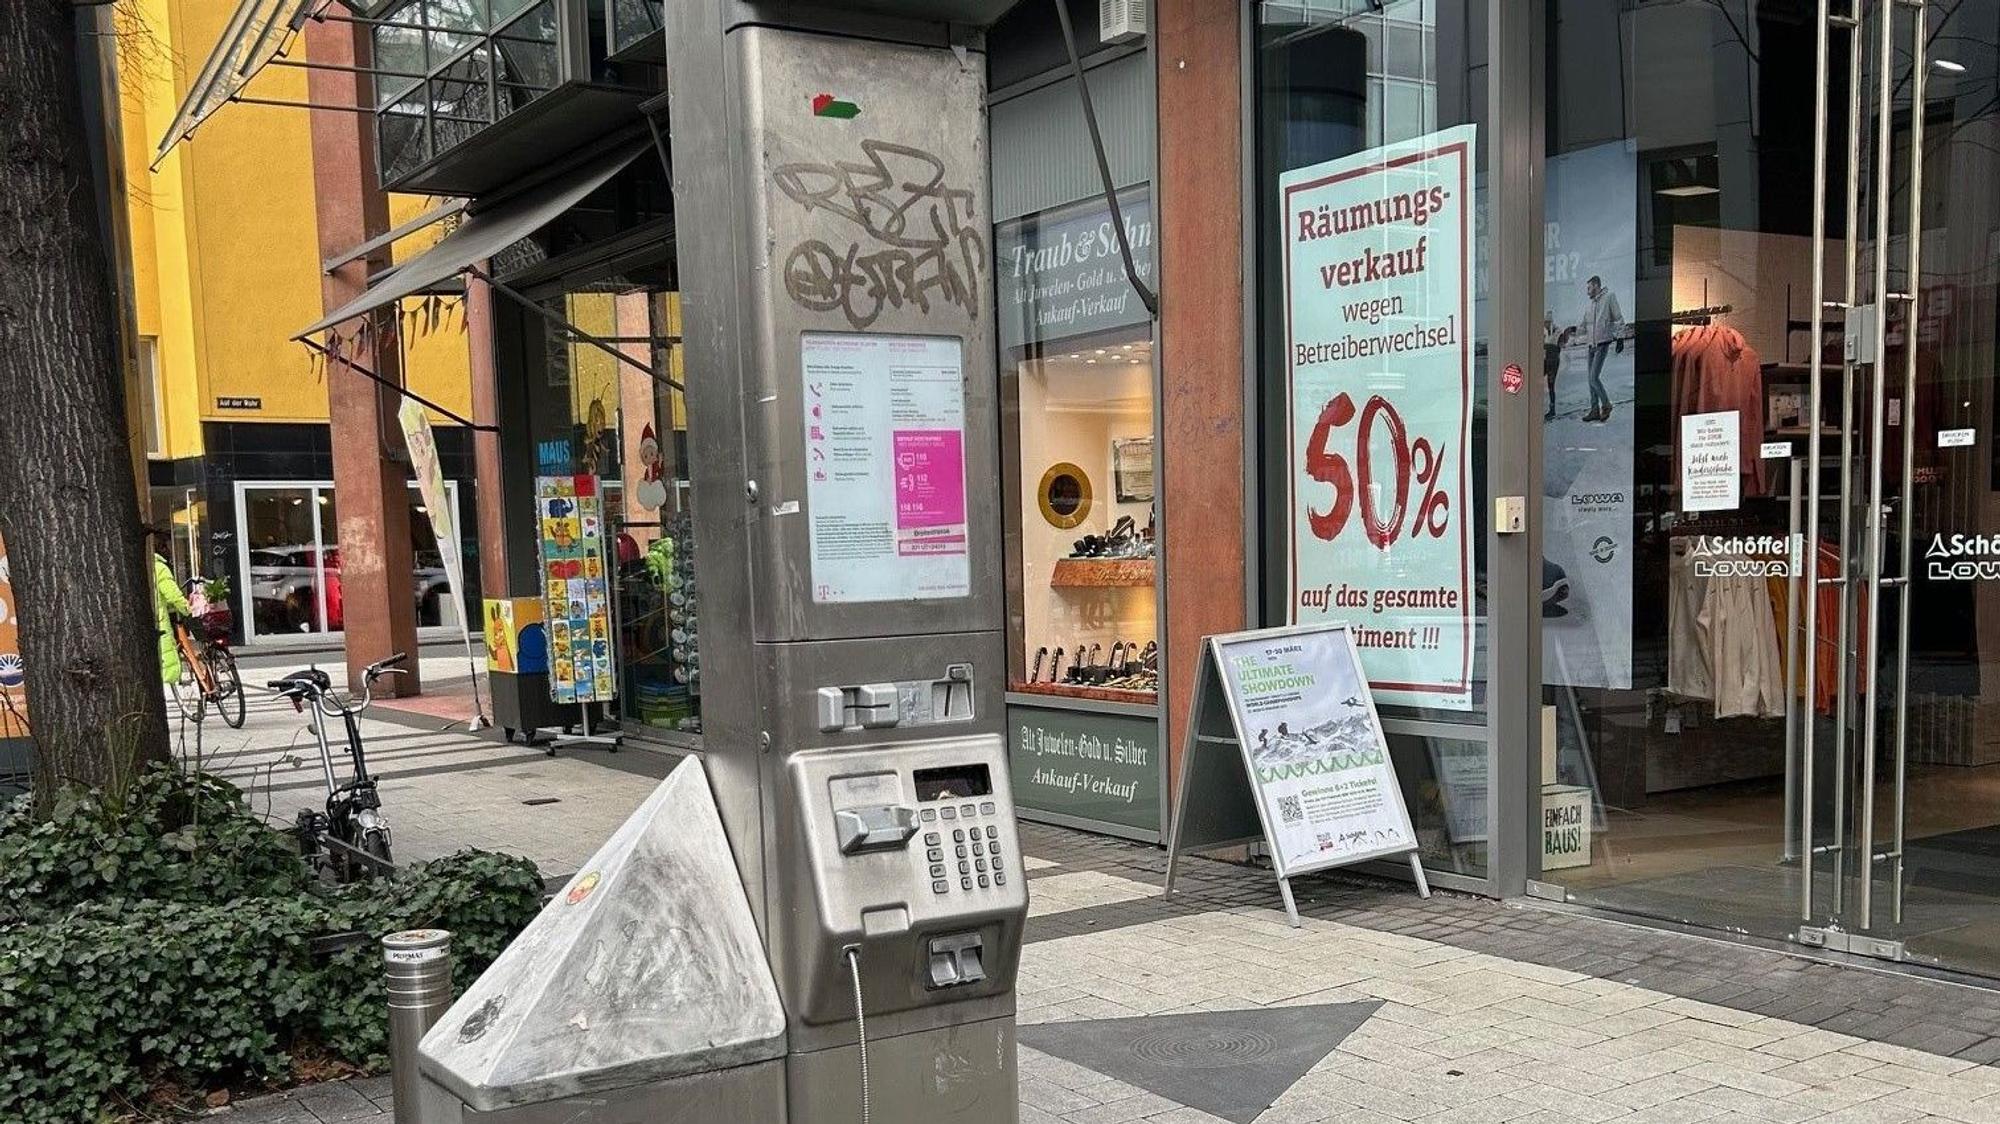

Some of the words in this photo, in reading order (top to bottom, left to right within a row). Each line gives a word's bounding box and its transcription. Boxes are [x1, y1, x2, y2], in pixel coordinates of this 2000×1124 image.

[1298, 185, 1451, 241] Räumungs-
[1012, 232, 1072, 278] Traub
[1320, 236, 1426, 289] verkauf
[1119, 259, 1152, 282] Sber
[1035, 288, 1130, 326] Ankauf-Verkauf
[1342, 295, 1404, 325] wegen
[1296, 315, 1456, 366] Betreiberwechsel
[1503, 374, 1522, 385] STOP
[539, 440, 570, 465] MAUS
[1303, 391, 1449, 551] 50%
[1571, 493, 1624, 504] LOWA
[1711, 535, 1790, 555] Schöffel
[1694, 560, 1789, 577] LOWA
[1301, 583, 1332, 613] auf
[1336, 583, 1369, 608] das
[1372, 586, 1459, 613] gesamte
[1351, 624, 1417, 650] iment
[1234, 655, 1258, 668] THE
[1238, 663, 1295, 681] ULTIMATE
[1241, 674, 1316, 695] SHOWDOWN
[1021, 725, 1036, 752] Alt
[1079, 733, 1101, 760] Gold
[1104, 743, 1113, 762] u.
[1115, 737, 1148, 766] Silber
[1031, 767, 1139, 803] Ankauf-Verkauf
[1545, 804, 1582, 828] EINFACH
[1545, 826, 1582, 856] RAUS!
